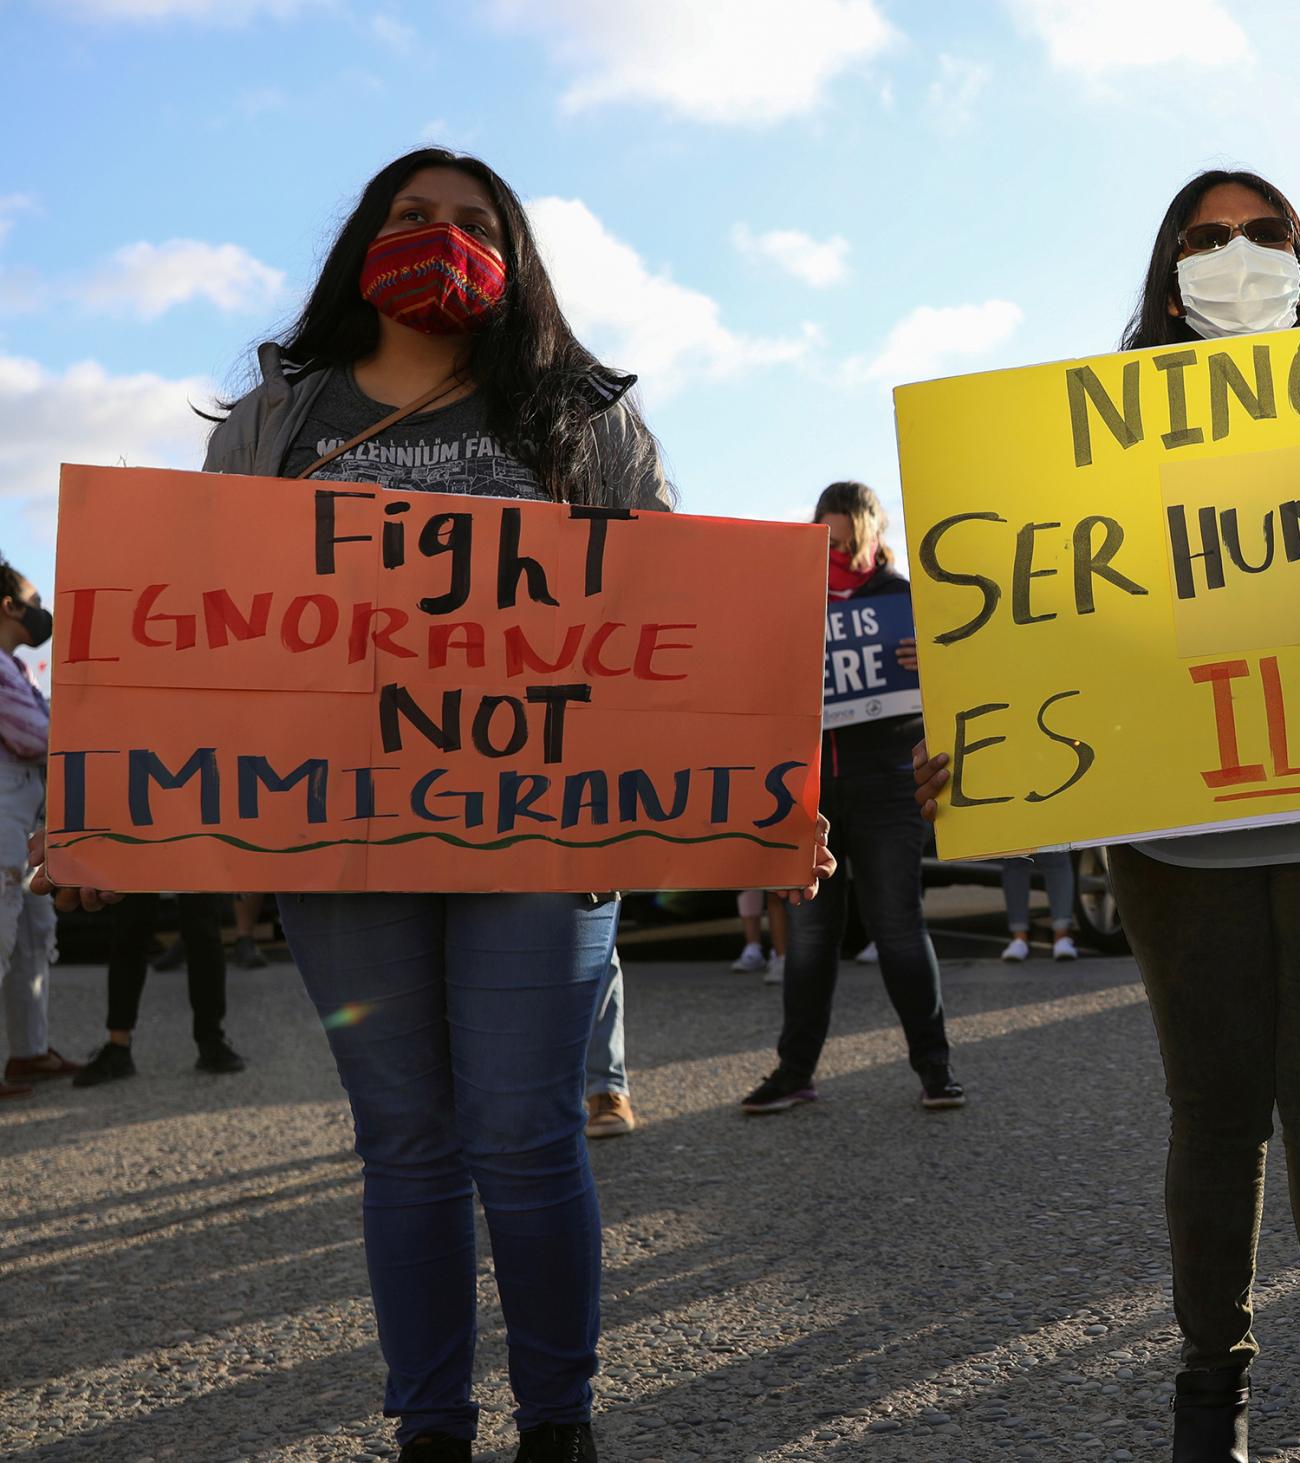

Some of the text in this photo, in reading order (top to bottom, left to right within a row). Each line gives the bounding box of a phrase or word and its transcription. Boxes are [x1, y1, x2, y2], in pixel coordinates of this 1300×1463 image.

[852, 607, 879, 637] IS
[919, 512, 1148, 644] SER
[62, 585, 697, 681] IGNORANCE
[380, 683, 592, 764] NOT
[951, 690, 1095, 806] ES
[50, 748, 808, 833] IMMIGRANTS
